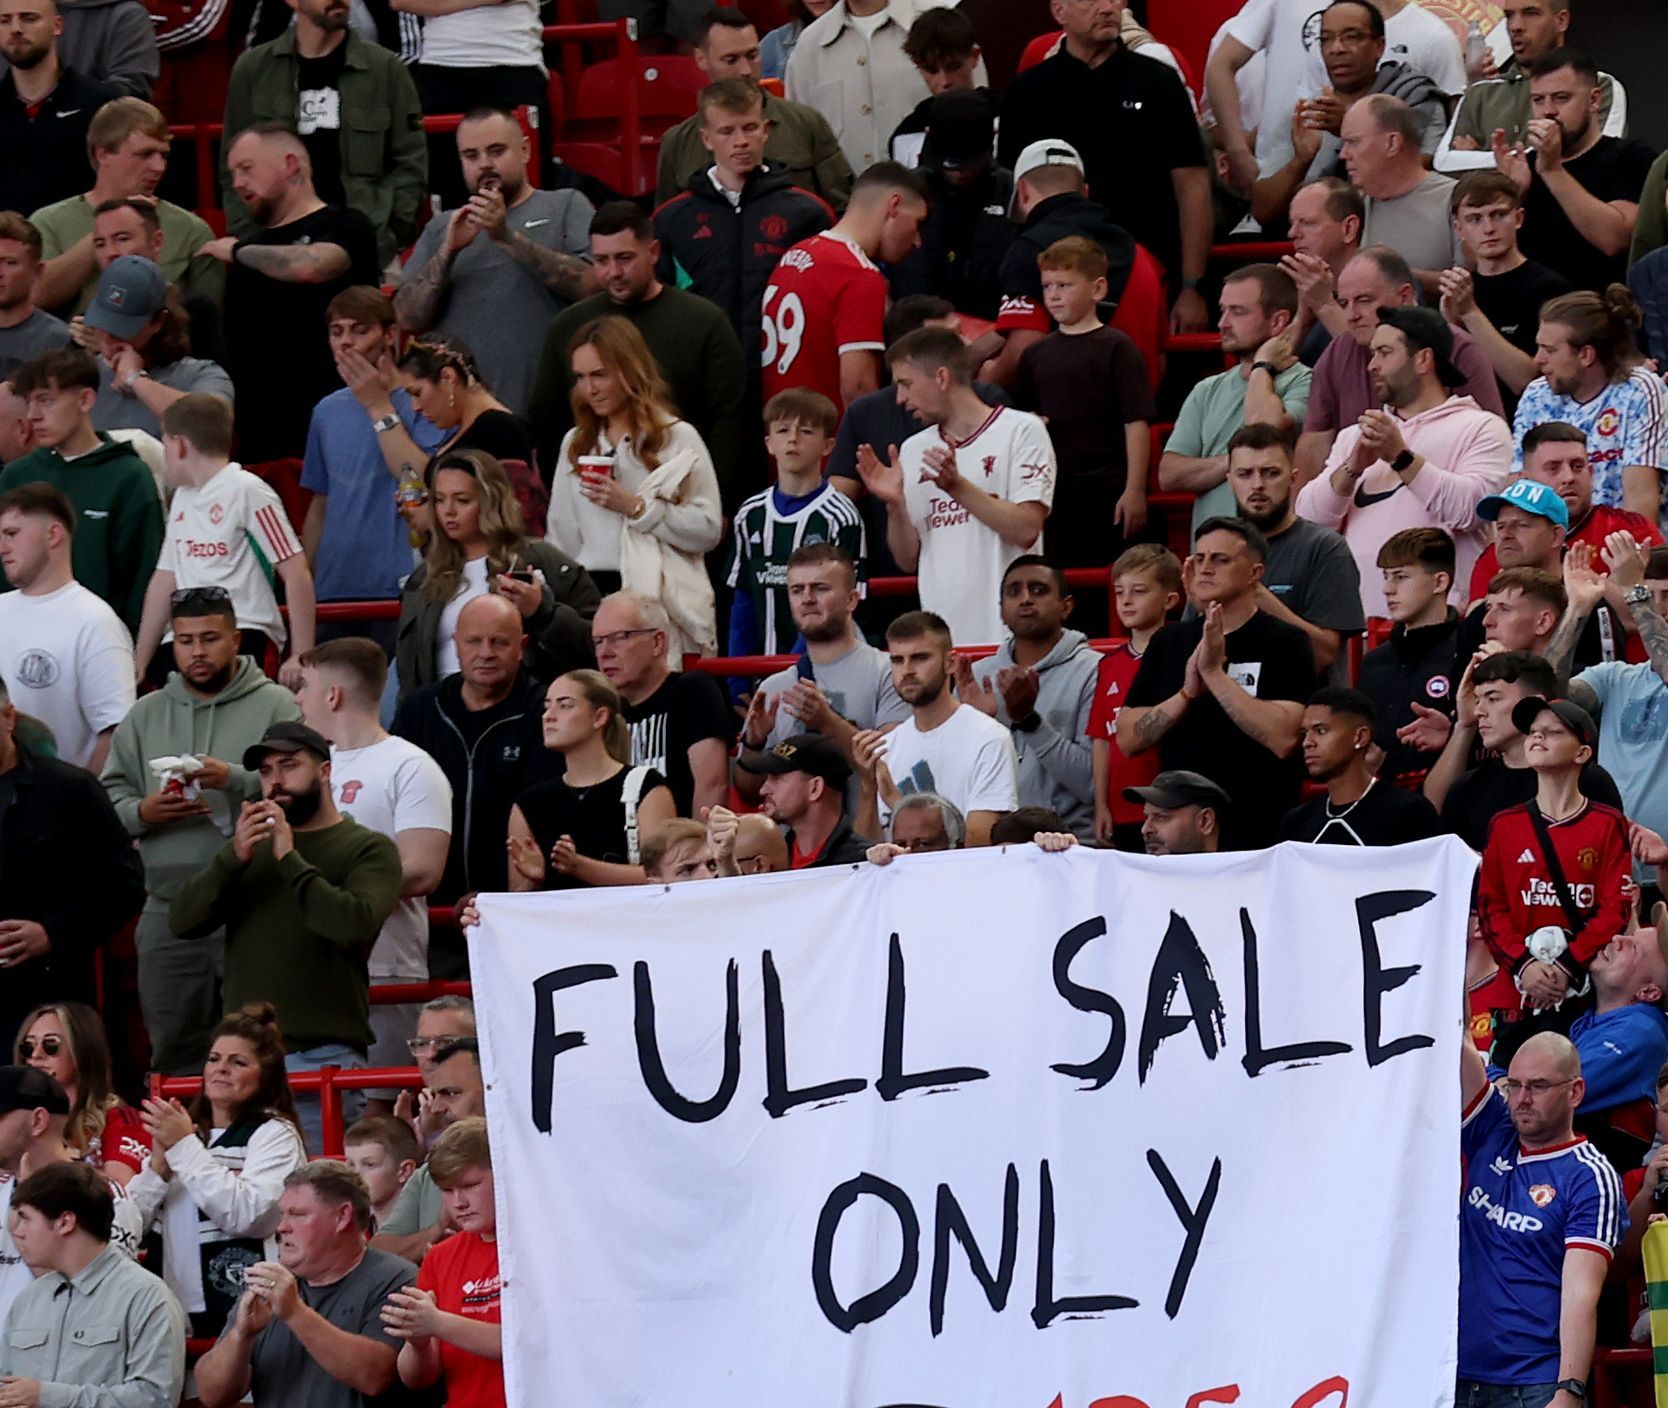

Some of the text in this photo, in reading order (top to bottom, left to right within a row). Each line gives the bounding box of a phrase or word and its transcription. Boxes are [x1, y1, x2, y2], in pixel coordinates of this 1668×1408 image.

[530, 888, 1438, 1135] FULL SALE
[812, 1147, 1222, 1339] ONLY
[1465, 1185, 1544, 1234] SHARP
